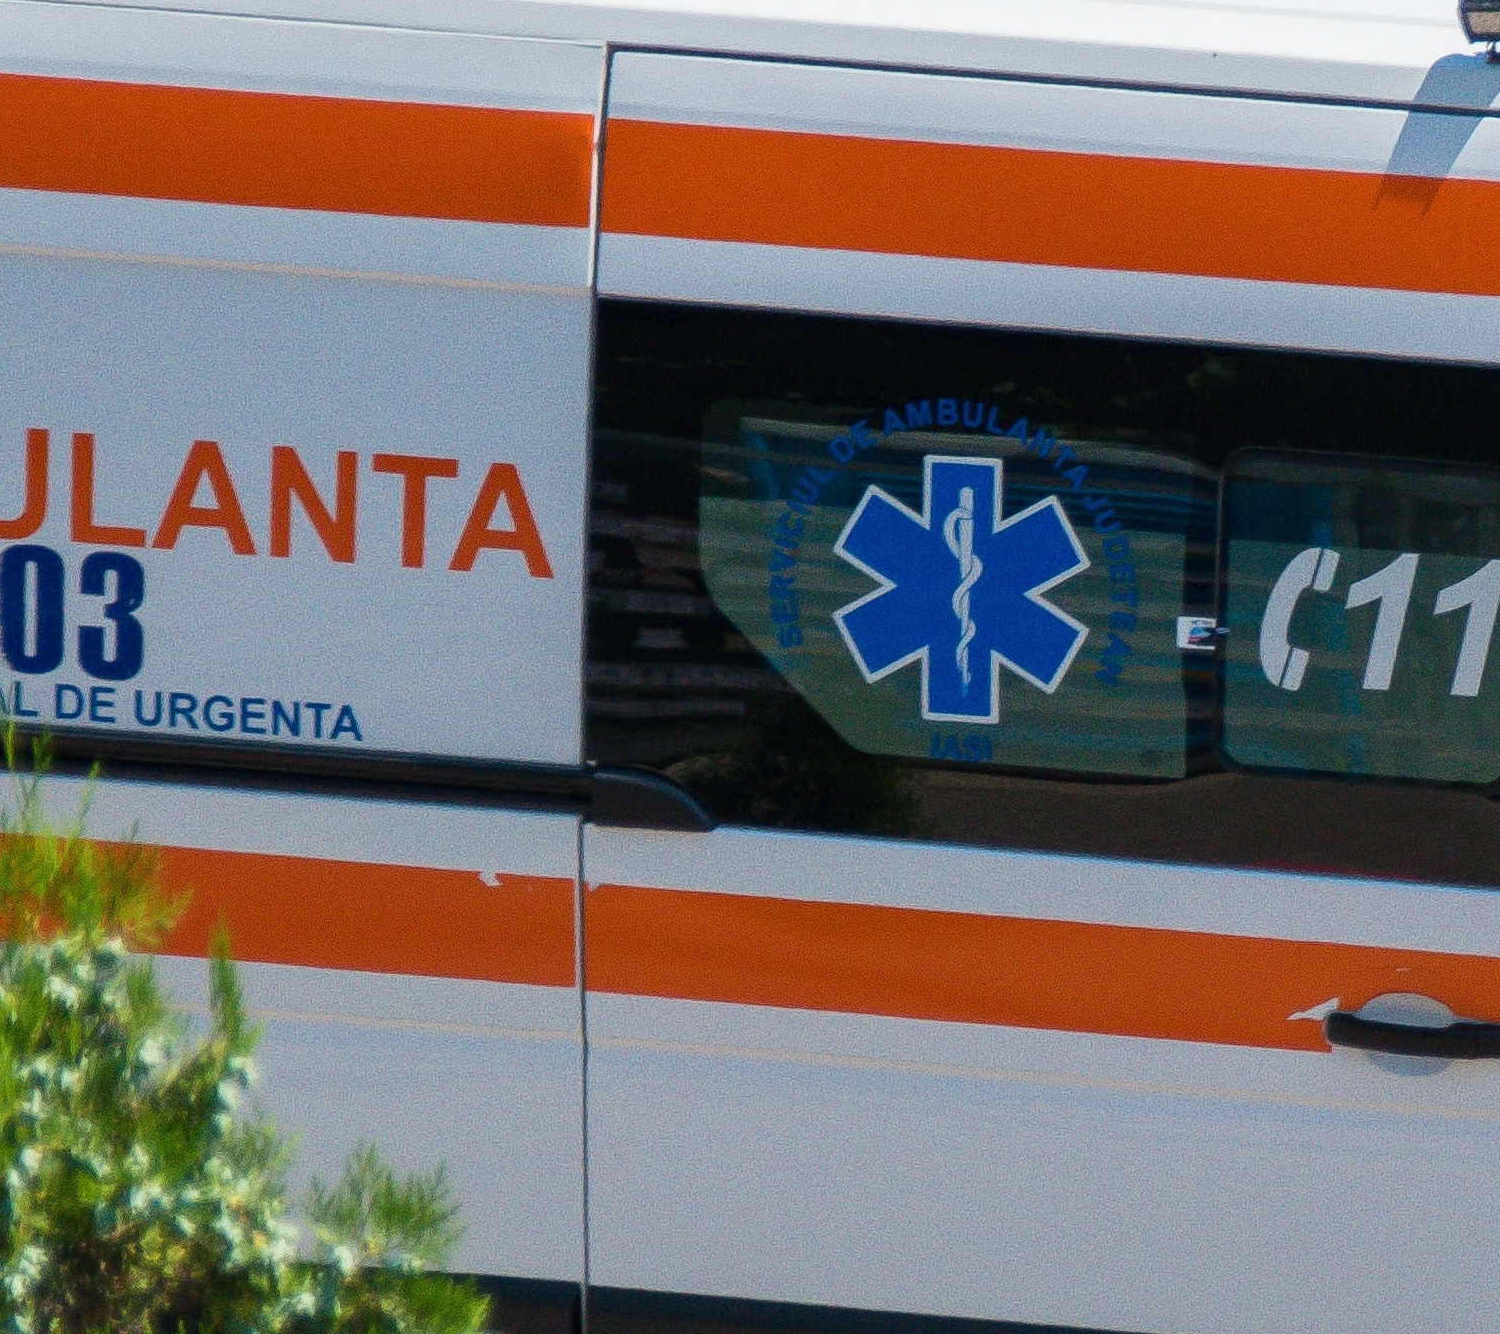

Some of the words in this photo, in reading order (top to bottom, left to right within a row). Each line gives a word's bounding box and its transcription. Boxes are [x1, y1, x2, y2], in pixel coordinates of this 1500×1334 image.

[828, 419, 878, 465] DE
[882, 397, 1089, 492] AMBULANTA
[54, 682, 117, 724] DE
[133, 689, 363, 742] URGENTA
